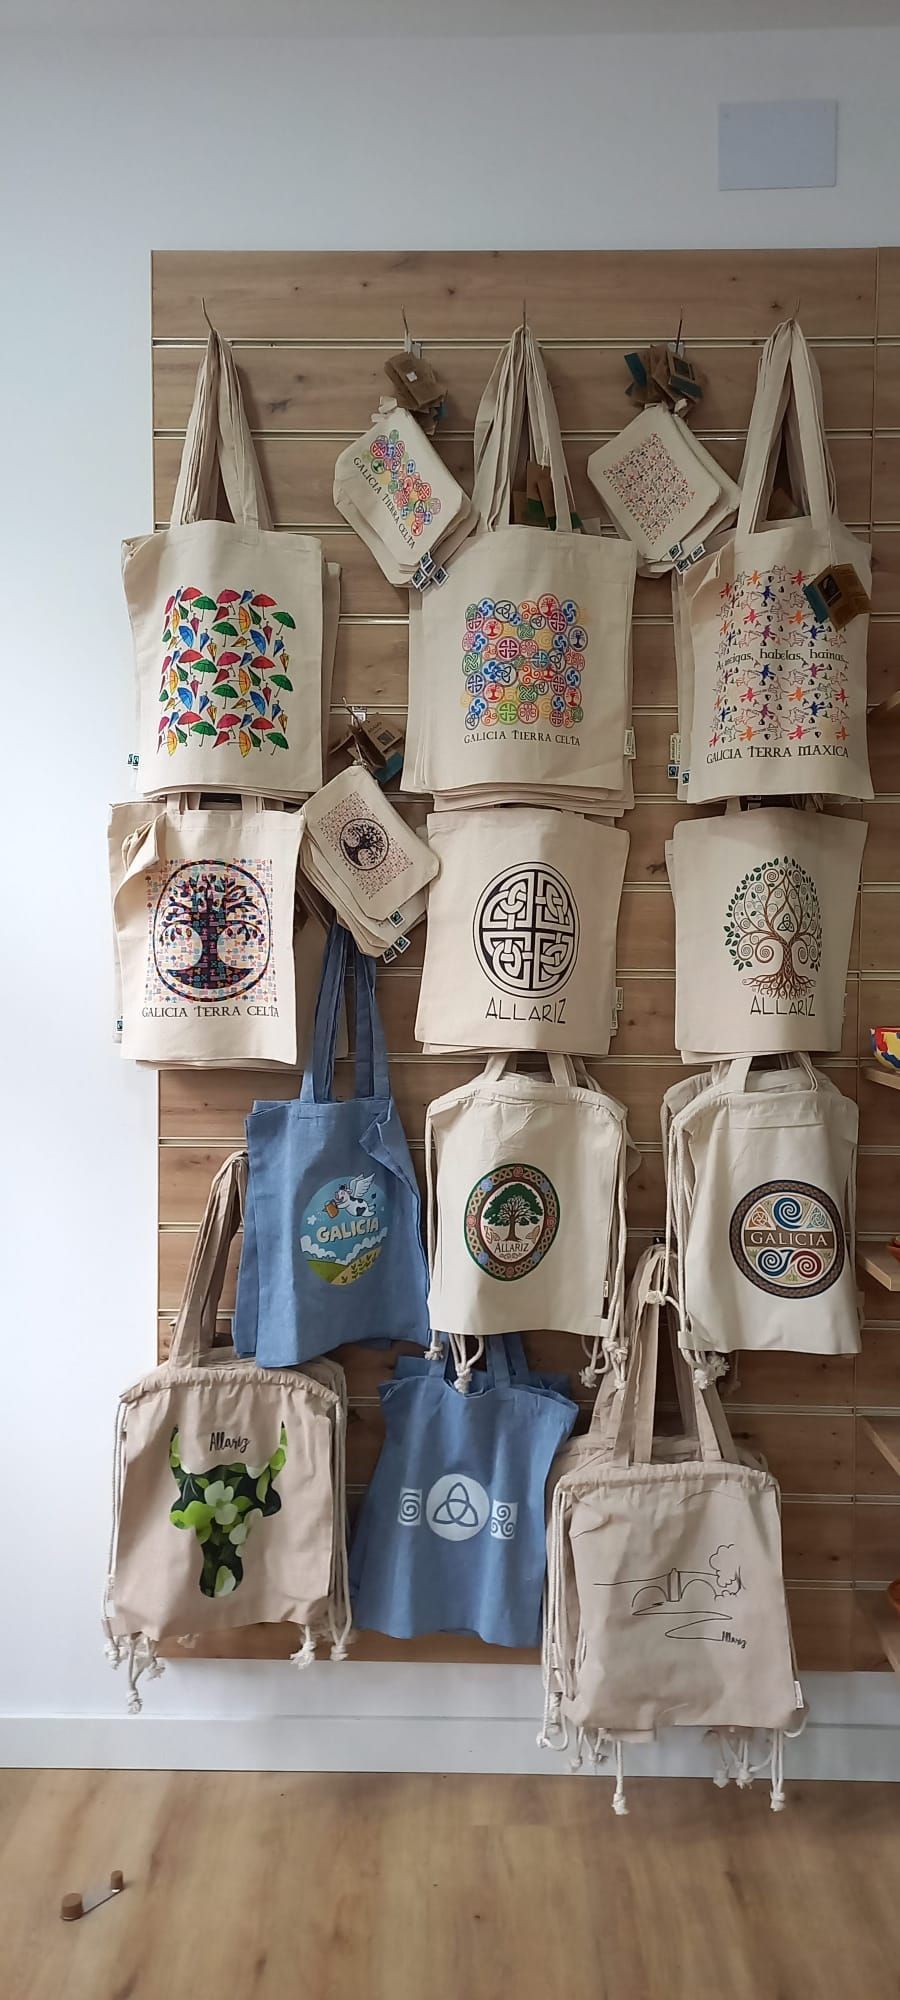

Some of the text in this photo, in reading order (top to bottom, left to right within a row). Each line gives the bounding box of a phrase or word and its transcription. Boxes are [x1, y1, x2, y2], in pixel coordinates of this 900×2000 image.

[353, 457, 416, 549] GALICIA TIERRA CELTA
[463, 729, 581, 746] GALICIA TIERRA CELTA
[706, 744, 849, 764] GALICIA TERRA MAXICA
[141, 1005, 280, 1018] GALICIA TERRA CELTA
[485, 996, 567, 1024] ALLARIZ
[750, 993, 816, 1017] ALLARIZ
[316, 1217, 379, 1243] GALICIA
[750, 1231, 828, 1246] GALICIA
[494, 1242, 530, 1253] ALLARIZ
[209, 1431, 250, 1454] Allariz
